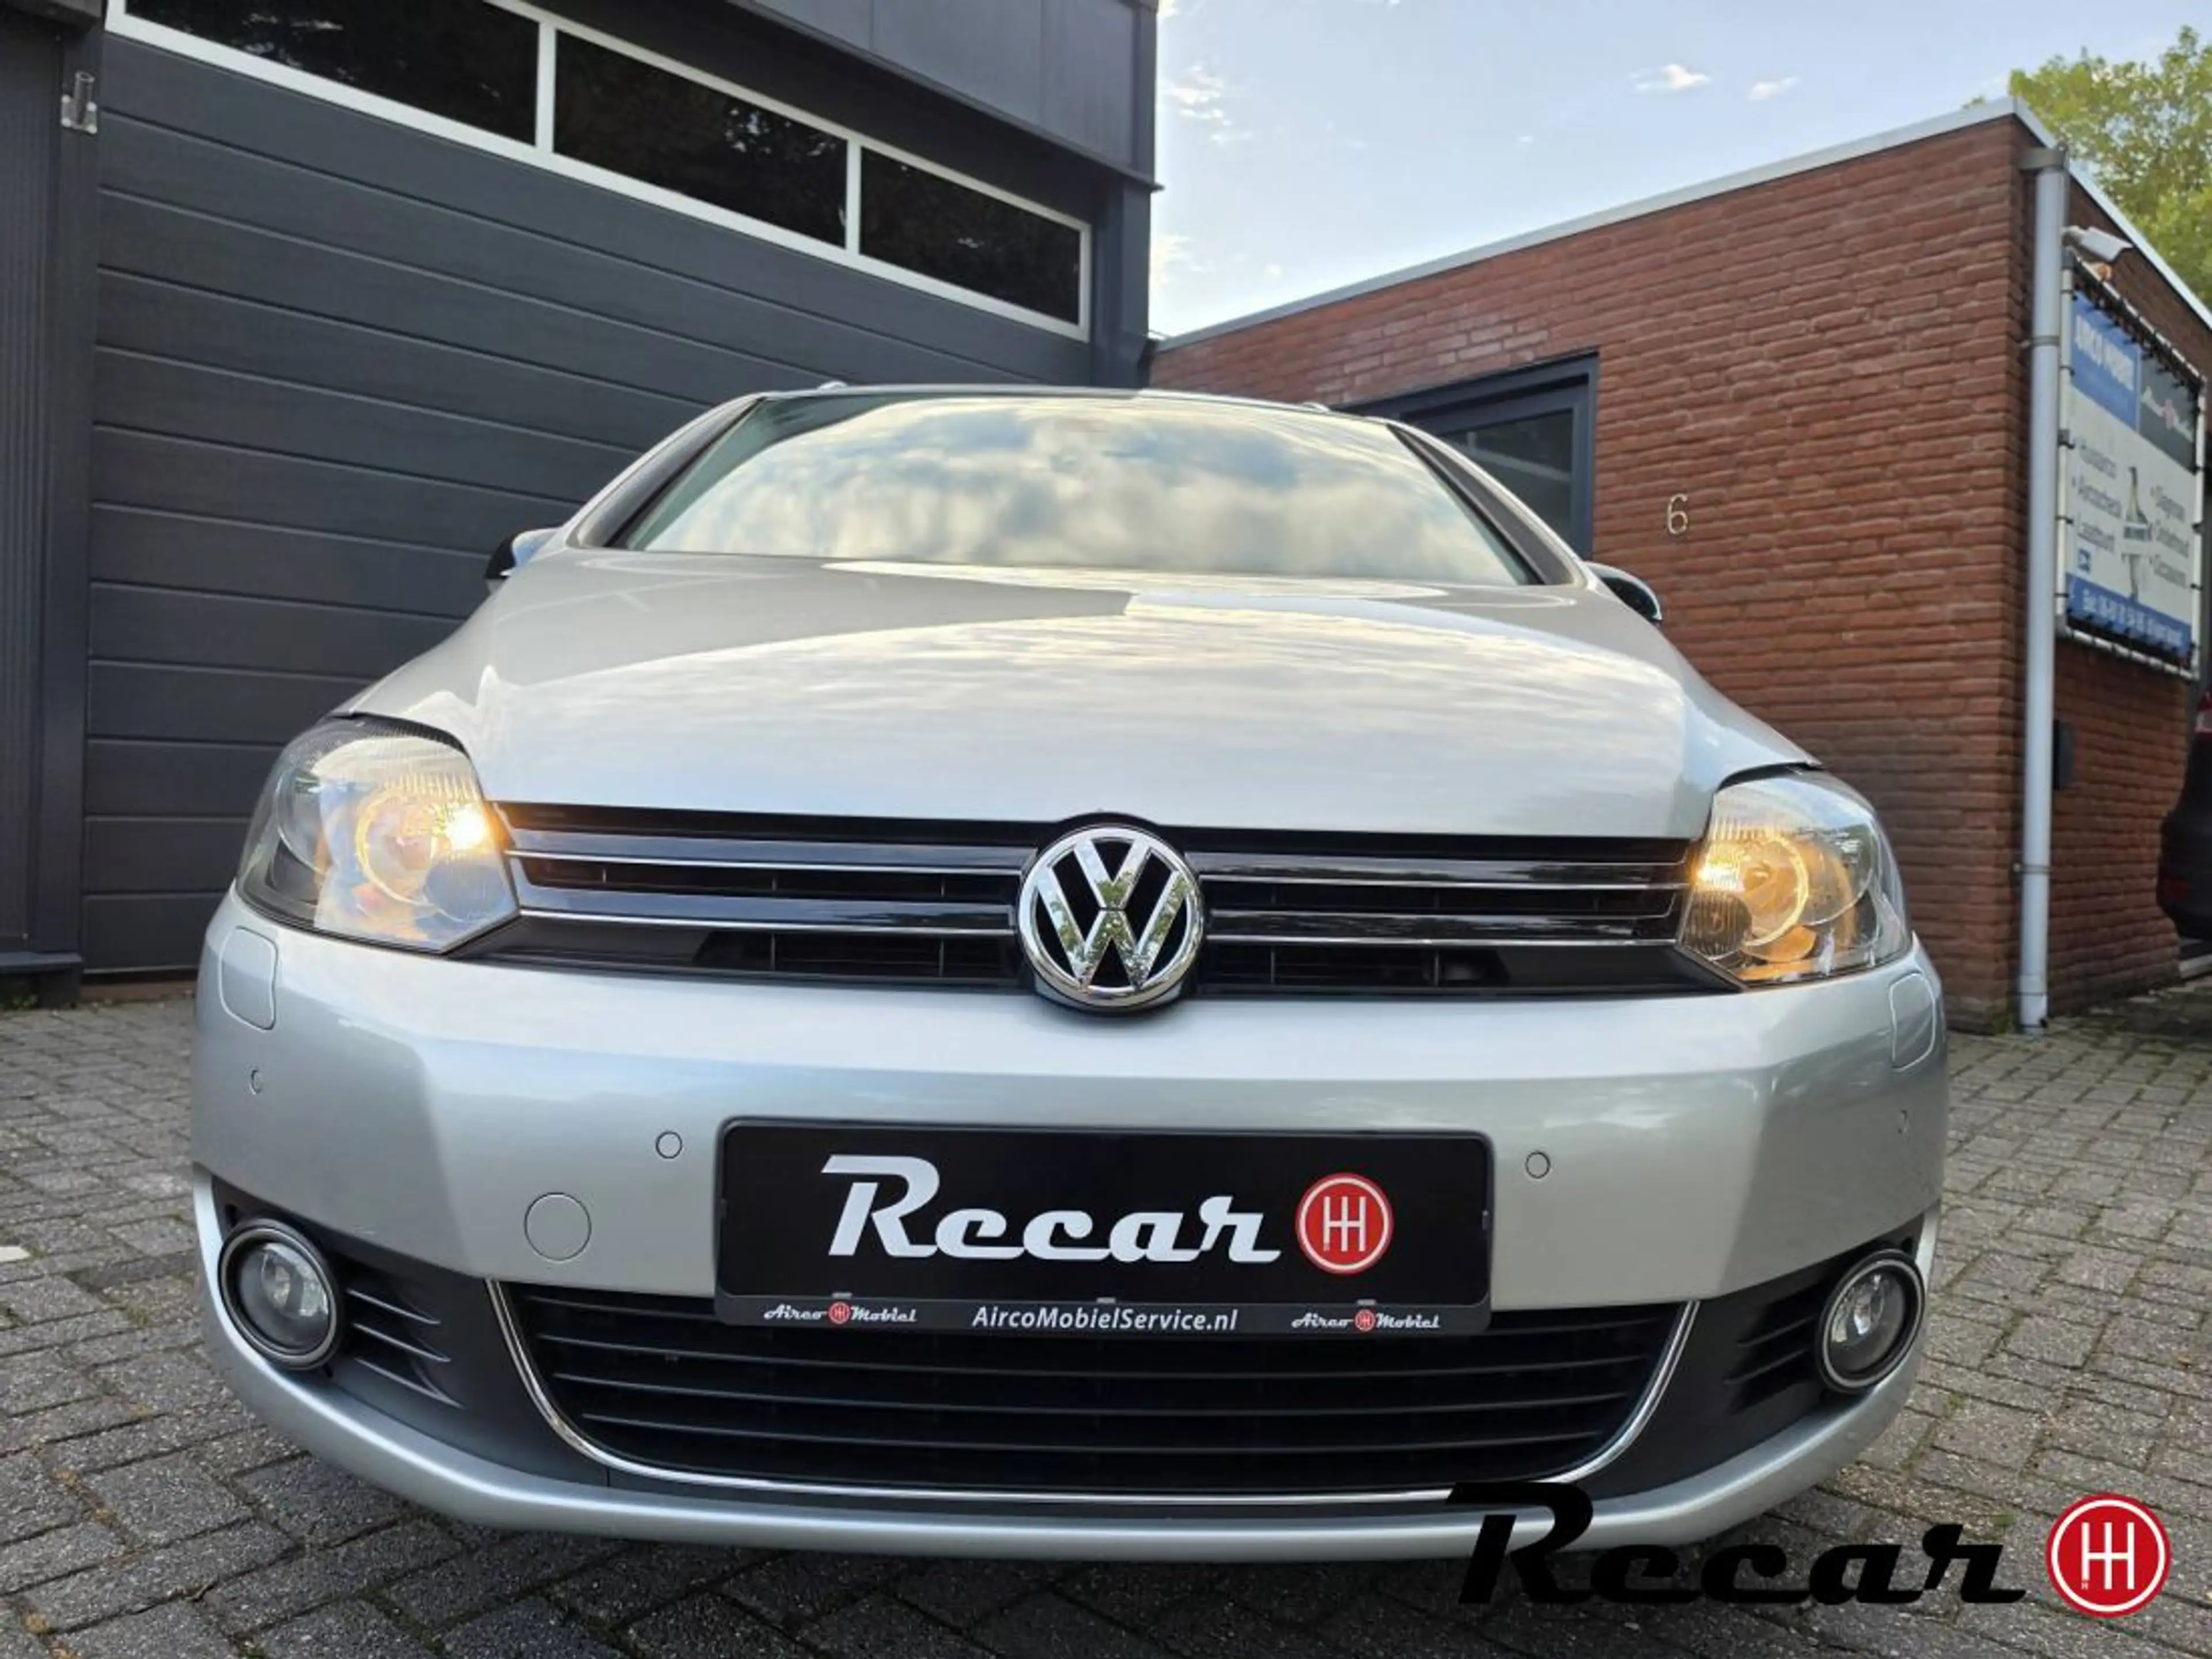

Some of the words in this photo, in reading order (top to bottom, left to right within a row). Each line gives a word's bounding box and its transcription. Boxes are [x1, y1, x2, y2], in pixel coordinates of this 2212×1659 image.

[1667, 493, 1688, 535] 6
[820, 1154, 1282, 1263] Recar
[763, 1303, 828, 1320] Airco
[850, 1305, 917, 1322] Mobiel
[972, 1305, 1238, 1331] AircoMobielService.nl
[1291, 1312, 1355, 1329] Airco
[1376, 1312, 1440, 1329] Mobiel
